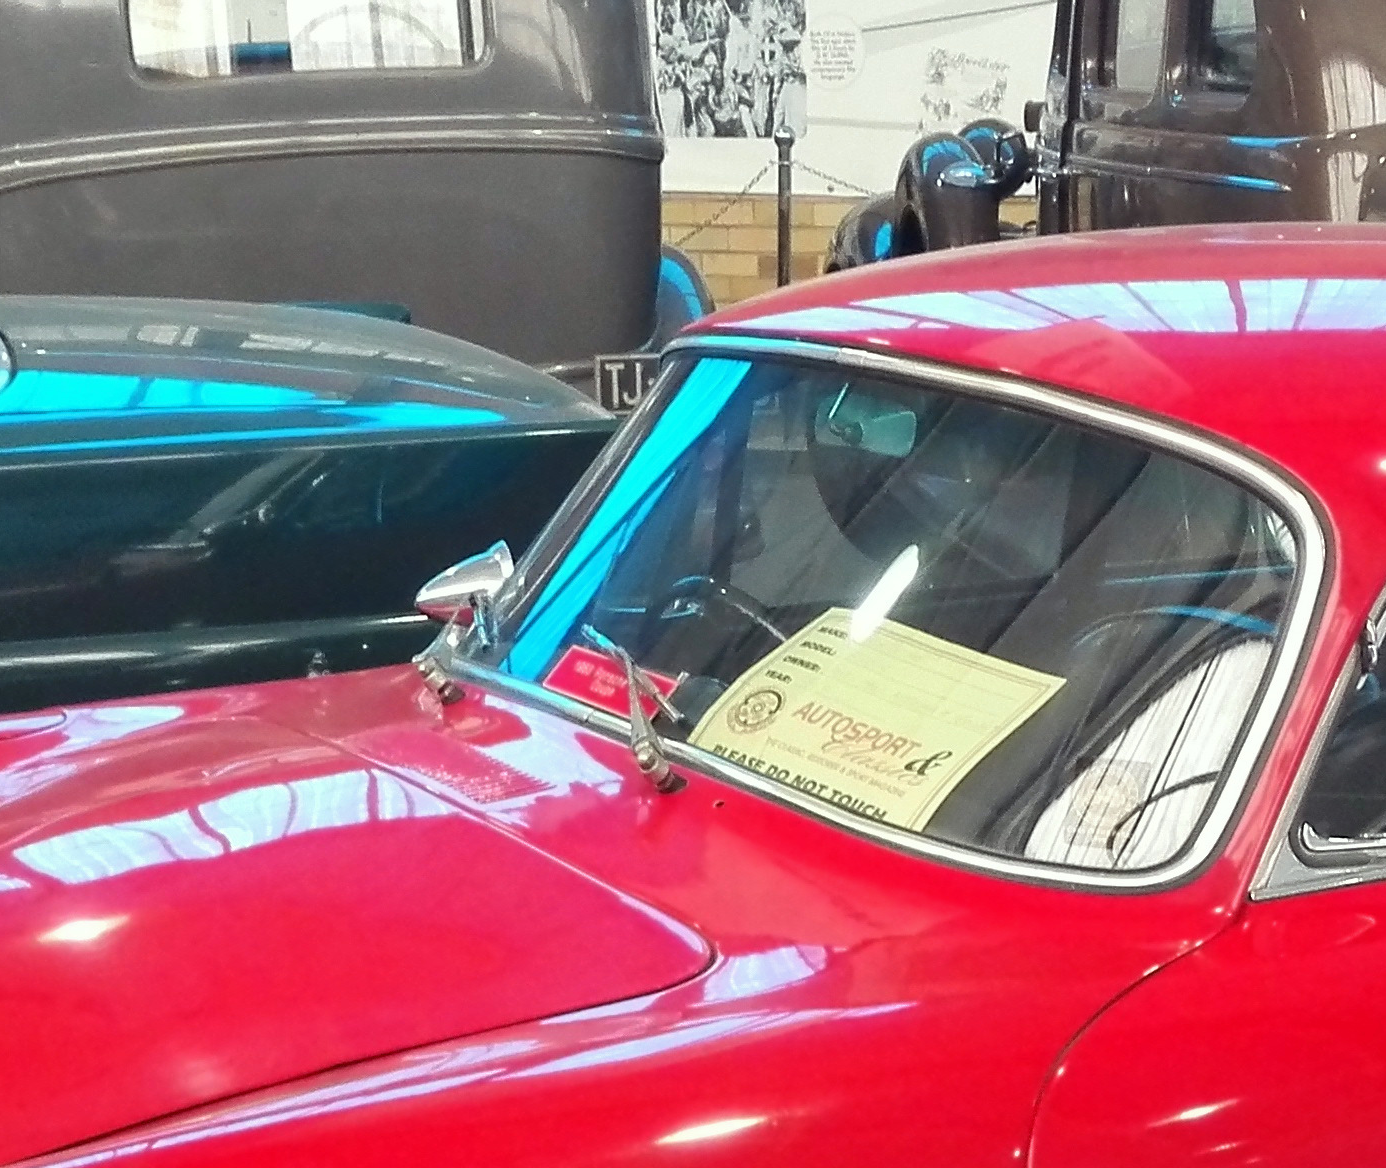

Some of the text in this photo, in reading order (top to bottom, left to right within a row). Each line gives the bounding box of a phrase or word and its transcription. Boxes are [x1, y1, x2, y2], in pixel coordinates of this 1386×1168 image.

[792, 702, 922, 759] AUTOSPORT
[713, 744, 764, 773] PLEASE
[766, 764, 790, 784] DO
[792, 775, 828, 800] NOT
[830, 789, 888, 820] TOUCH
